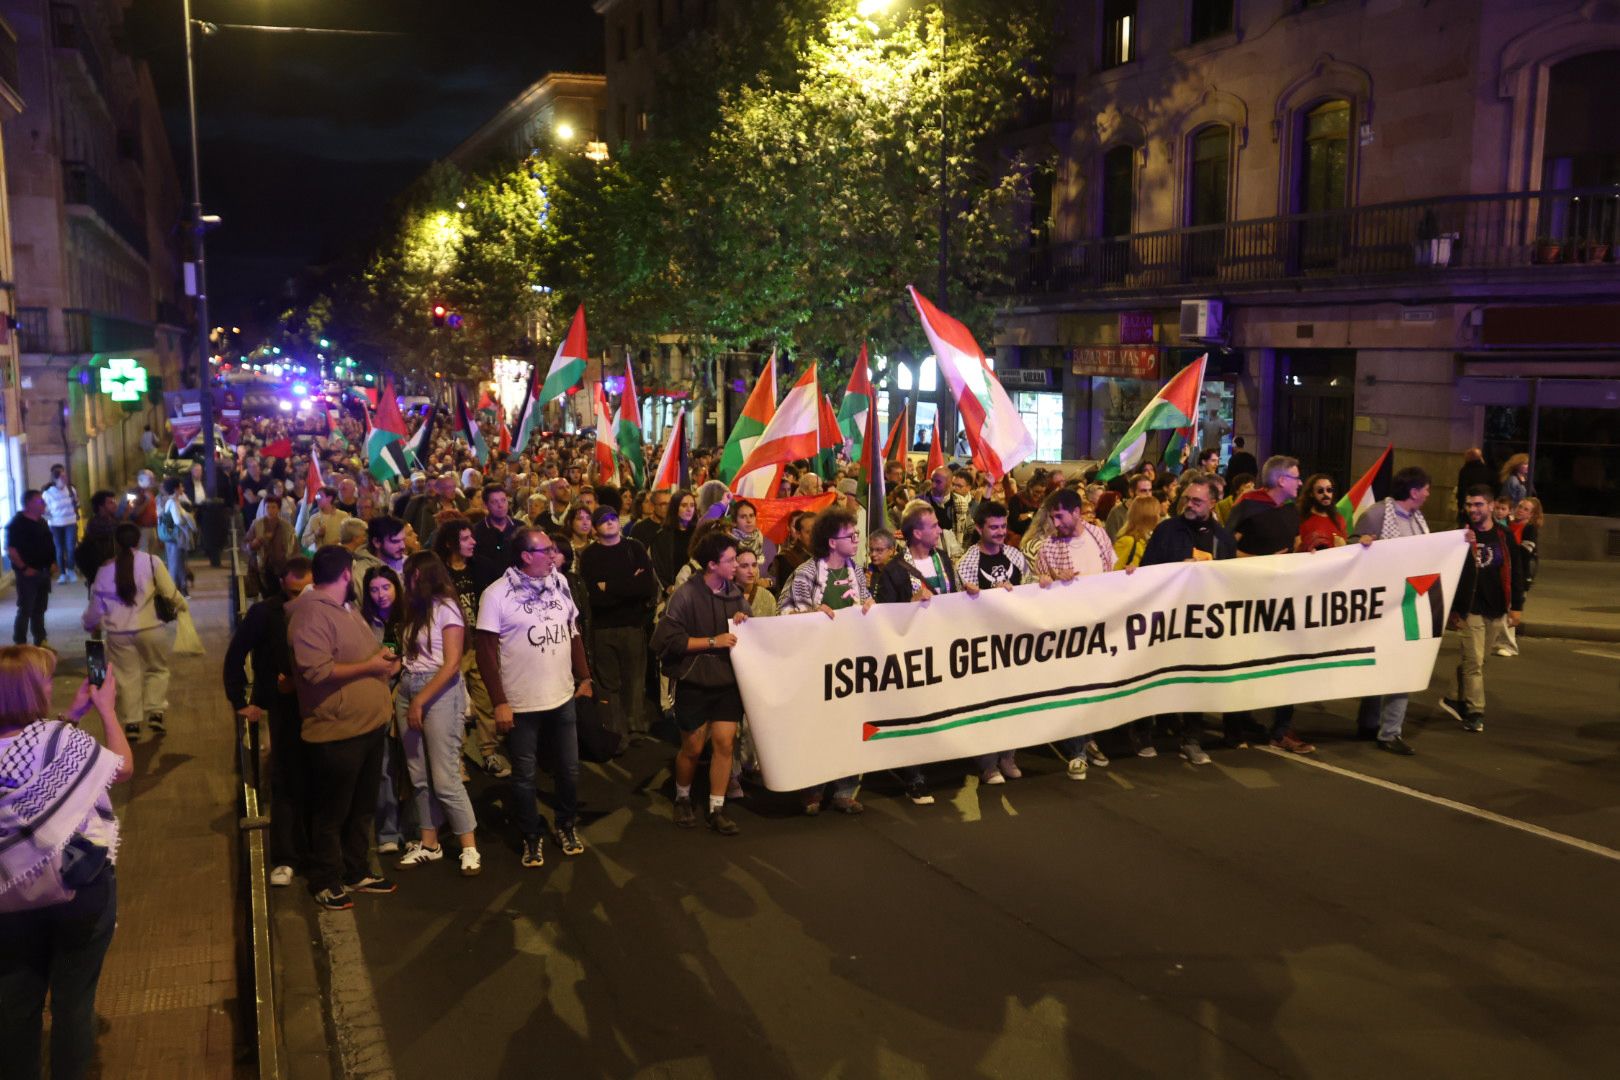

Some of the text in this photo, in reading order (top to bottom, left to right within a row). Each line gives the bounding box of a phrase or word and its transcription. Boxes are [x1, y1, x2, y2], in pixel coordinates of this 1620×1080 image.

[1073, 348, 1102, 365] BAZAR
[527, 624, 568, 647] GAZA
[824, 586, 1387, 702] ISRAEL GENOCIDA, PALESTINA LIBRE
